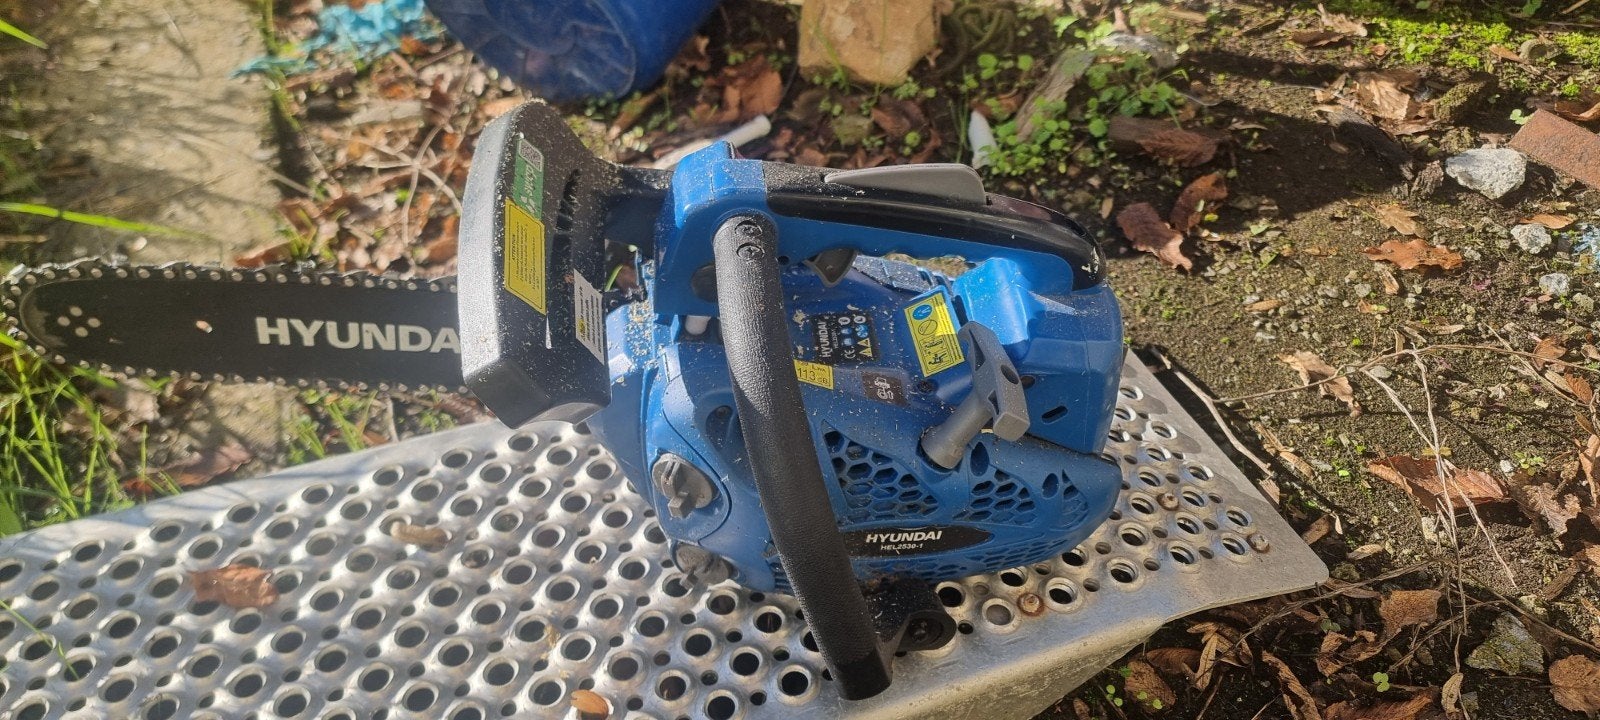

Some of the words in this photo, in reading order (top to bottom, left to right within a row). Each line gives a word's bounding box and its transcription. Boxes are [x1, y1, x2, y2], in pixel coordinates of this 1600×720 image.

[254, 316, 461, 354] HYUNDA
[818, 320, 831, 358] HYUNDAI
[797, 368, 816, 381] 113
[865, 530, 943, 543] HYUNDAI
